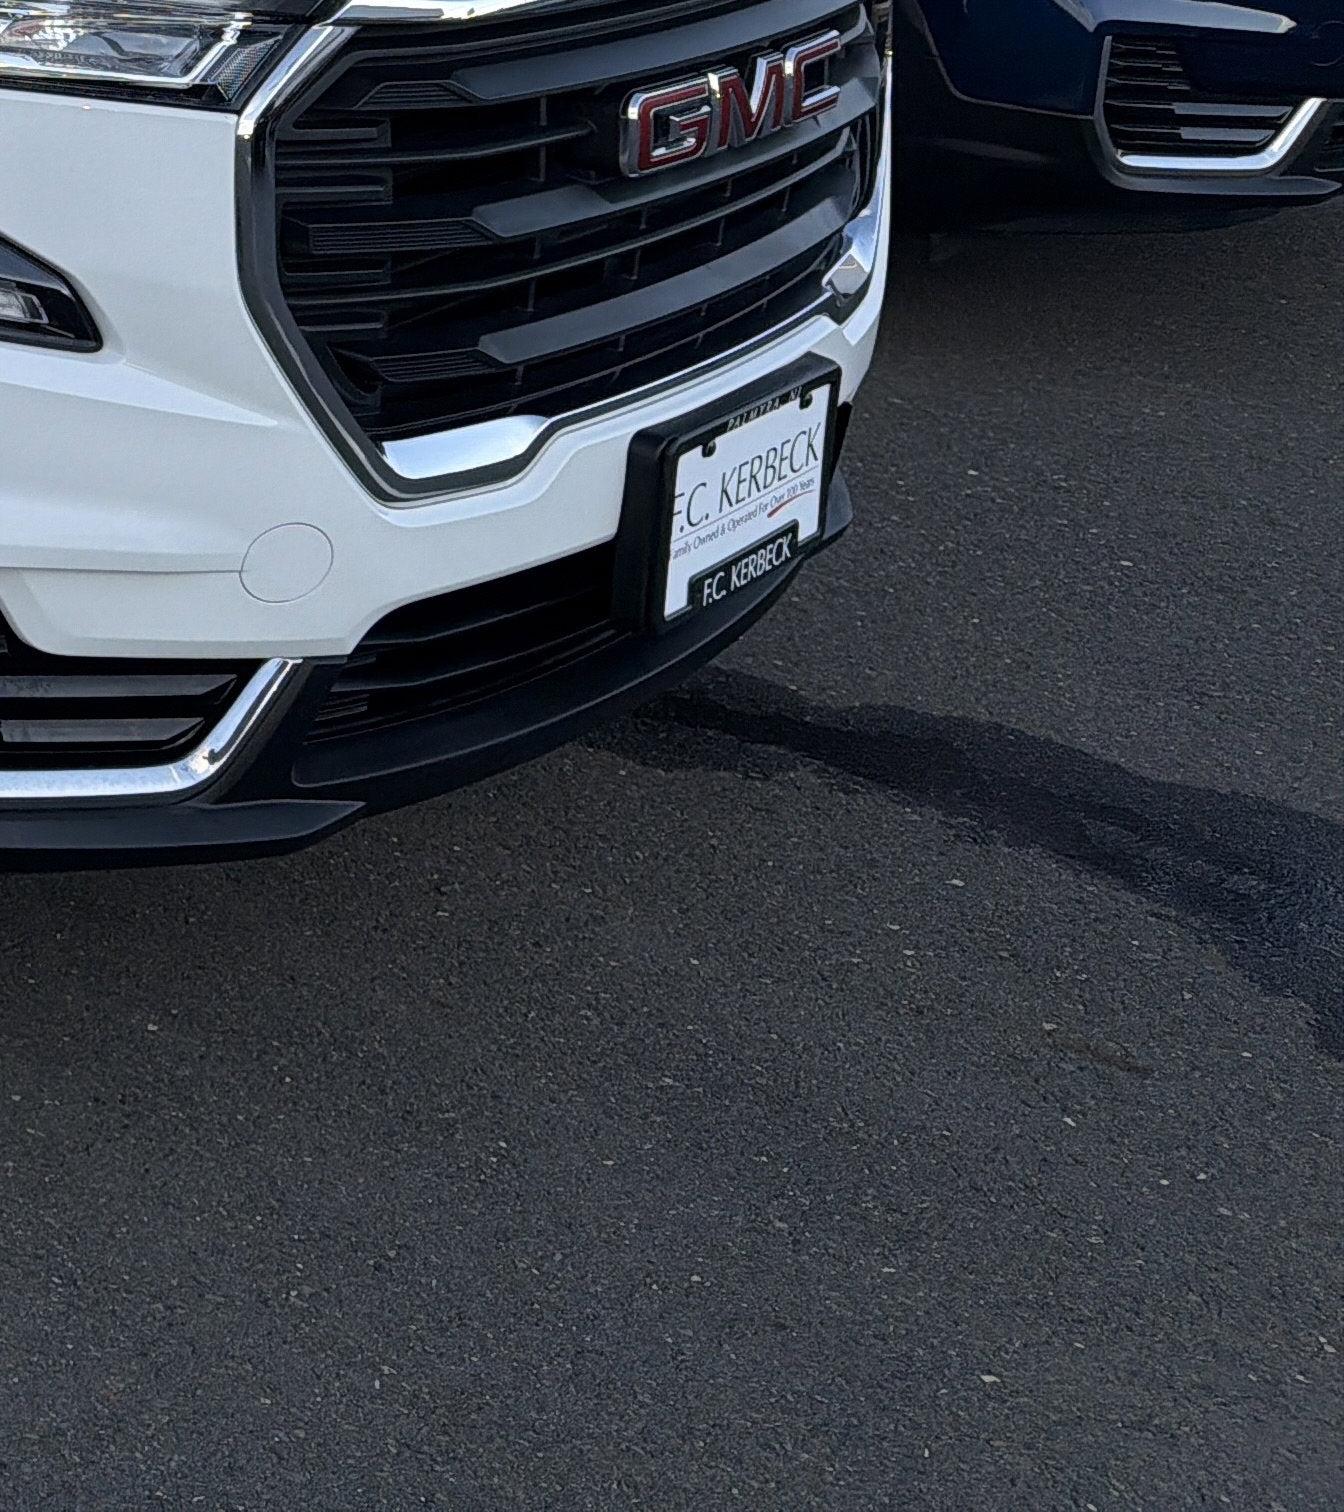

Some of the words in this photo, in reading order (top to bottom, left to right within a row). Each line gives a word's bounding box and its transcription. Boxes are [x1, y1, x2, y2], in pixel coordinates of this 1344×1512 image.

[618, 28, 842, 177] GMC
[727, 397, 781, 432] PALMYRA
[718, 421, 822, 514] KERBECK
[672, 540, 692, 561] amily
[693, 524, 720, 550] Owned
[727, 502, 758, 532] Operated
[758, 501, 769, 515] For
[768, 491, 786, 508] Over
[799, 477, 815, 492] Years
[702, 572, 727, 607] F.C.
[730, 532, 793, 592] KERBECK
